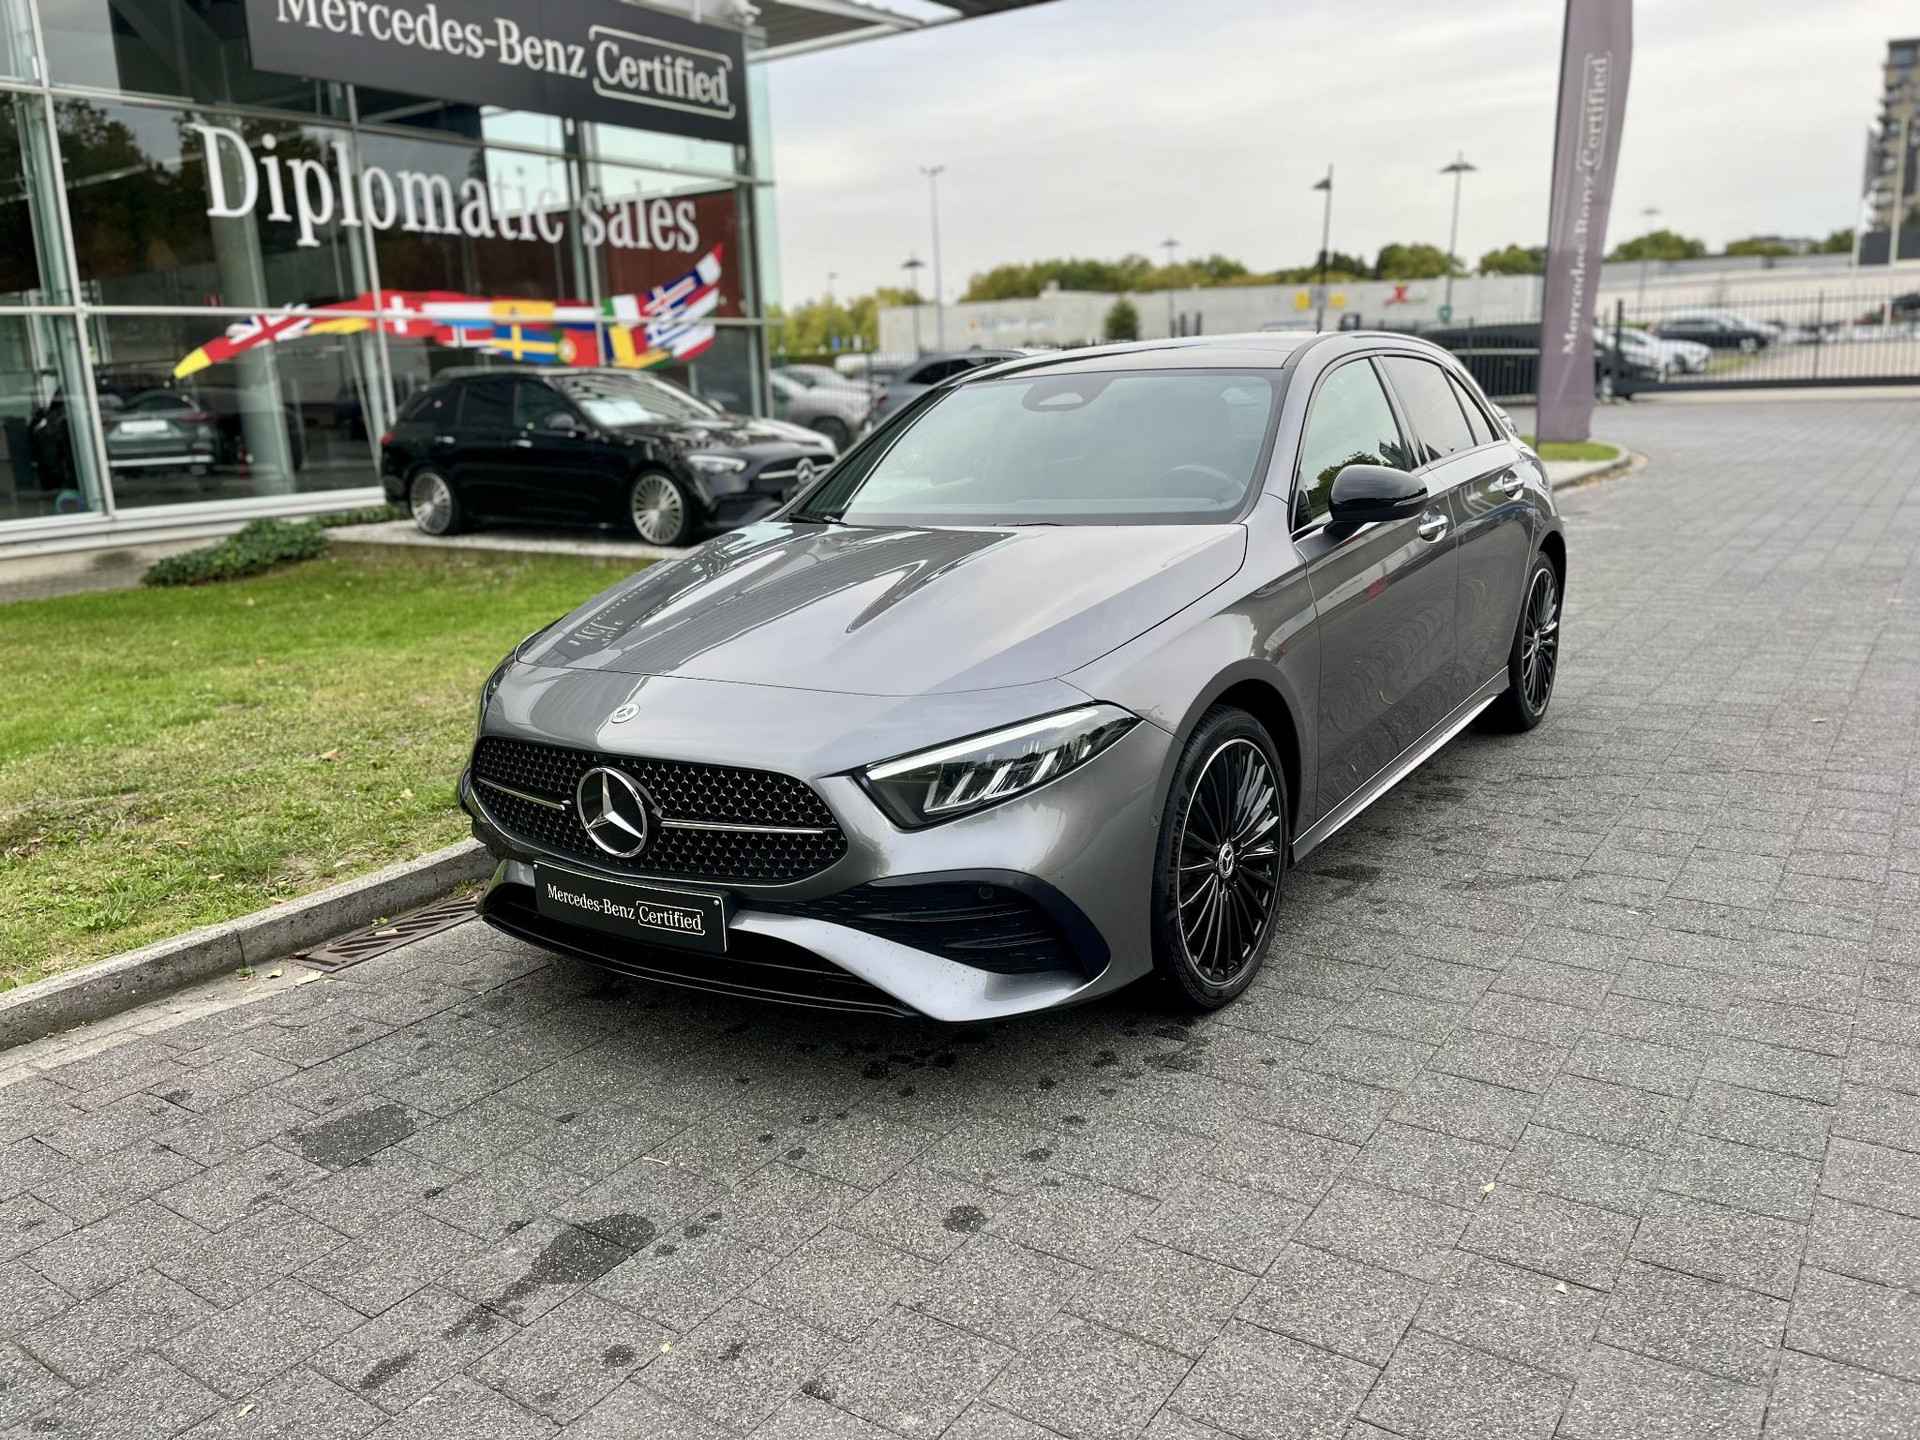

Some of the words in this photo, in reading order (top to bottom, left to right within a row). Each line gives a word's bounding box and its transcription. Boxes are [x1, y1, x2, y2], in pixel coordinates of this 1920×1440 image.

[596, 40, 728, 107] Certified
[1582, 58, 1606, 166] Certified
[182, 122, 565, 247] Diplomatic
[581, 179, 699, 252] sales
[546, 883, 636, 920] Mercedes-Benz
[639, 905, 703, 931] Certified
